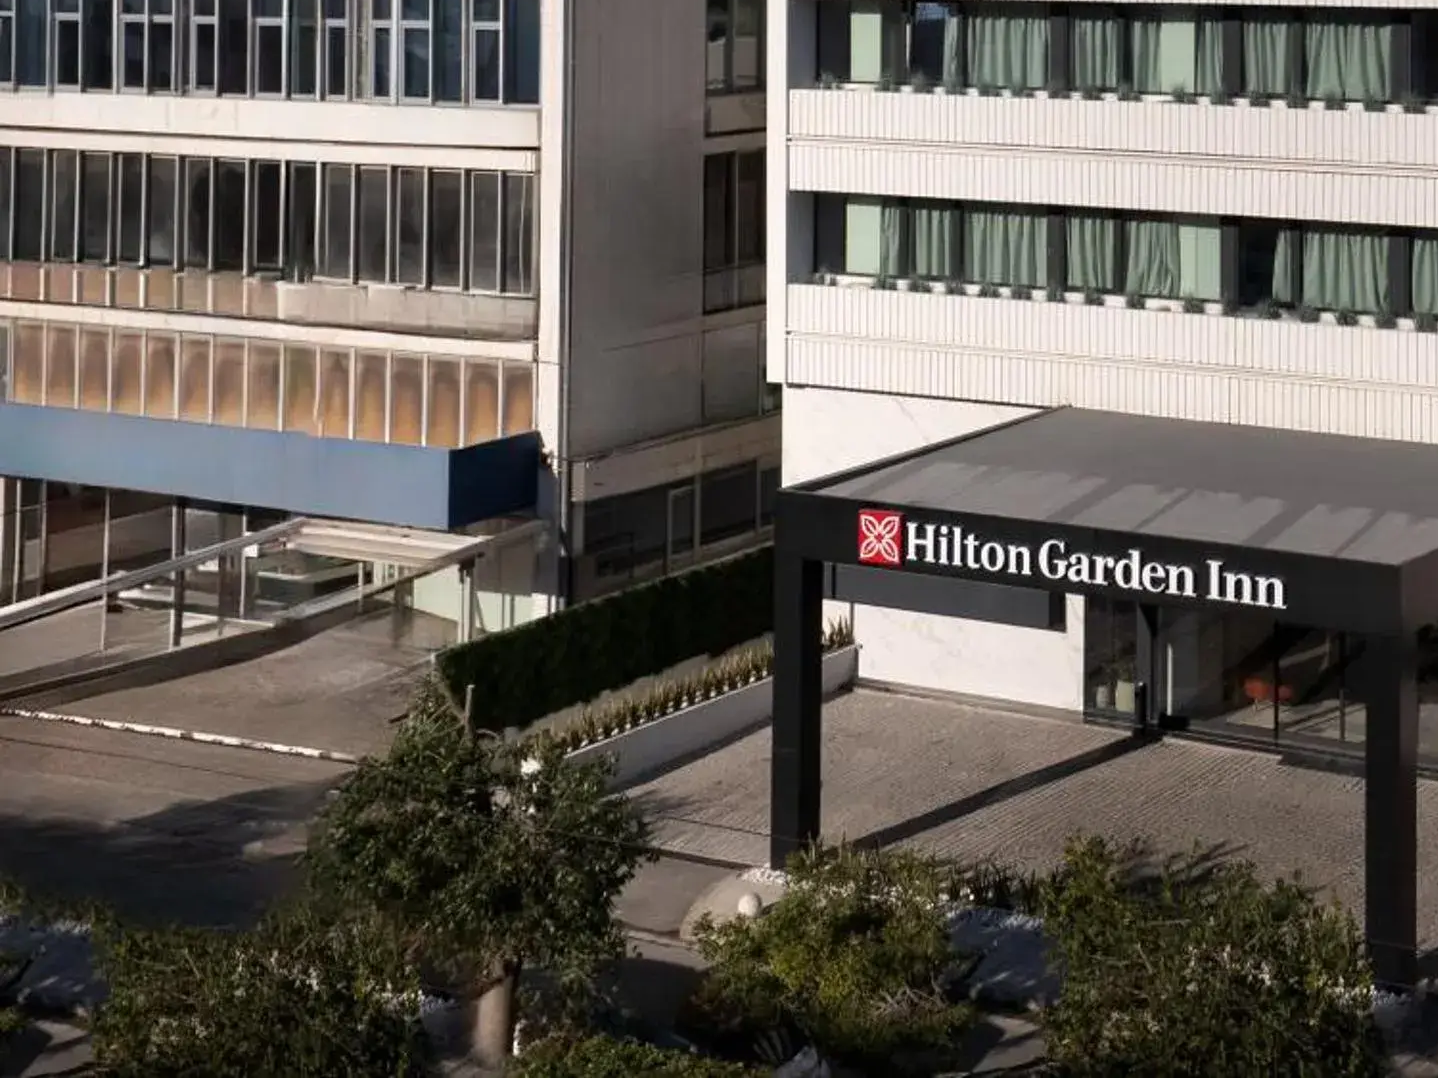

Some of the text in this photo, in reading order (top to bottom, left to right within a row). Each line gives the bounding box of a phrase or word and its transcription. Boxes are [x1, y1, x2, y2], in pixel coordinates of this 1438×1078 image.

[905, 520, 1288, 610] Hilton Garden Inn
